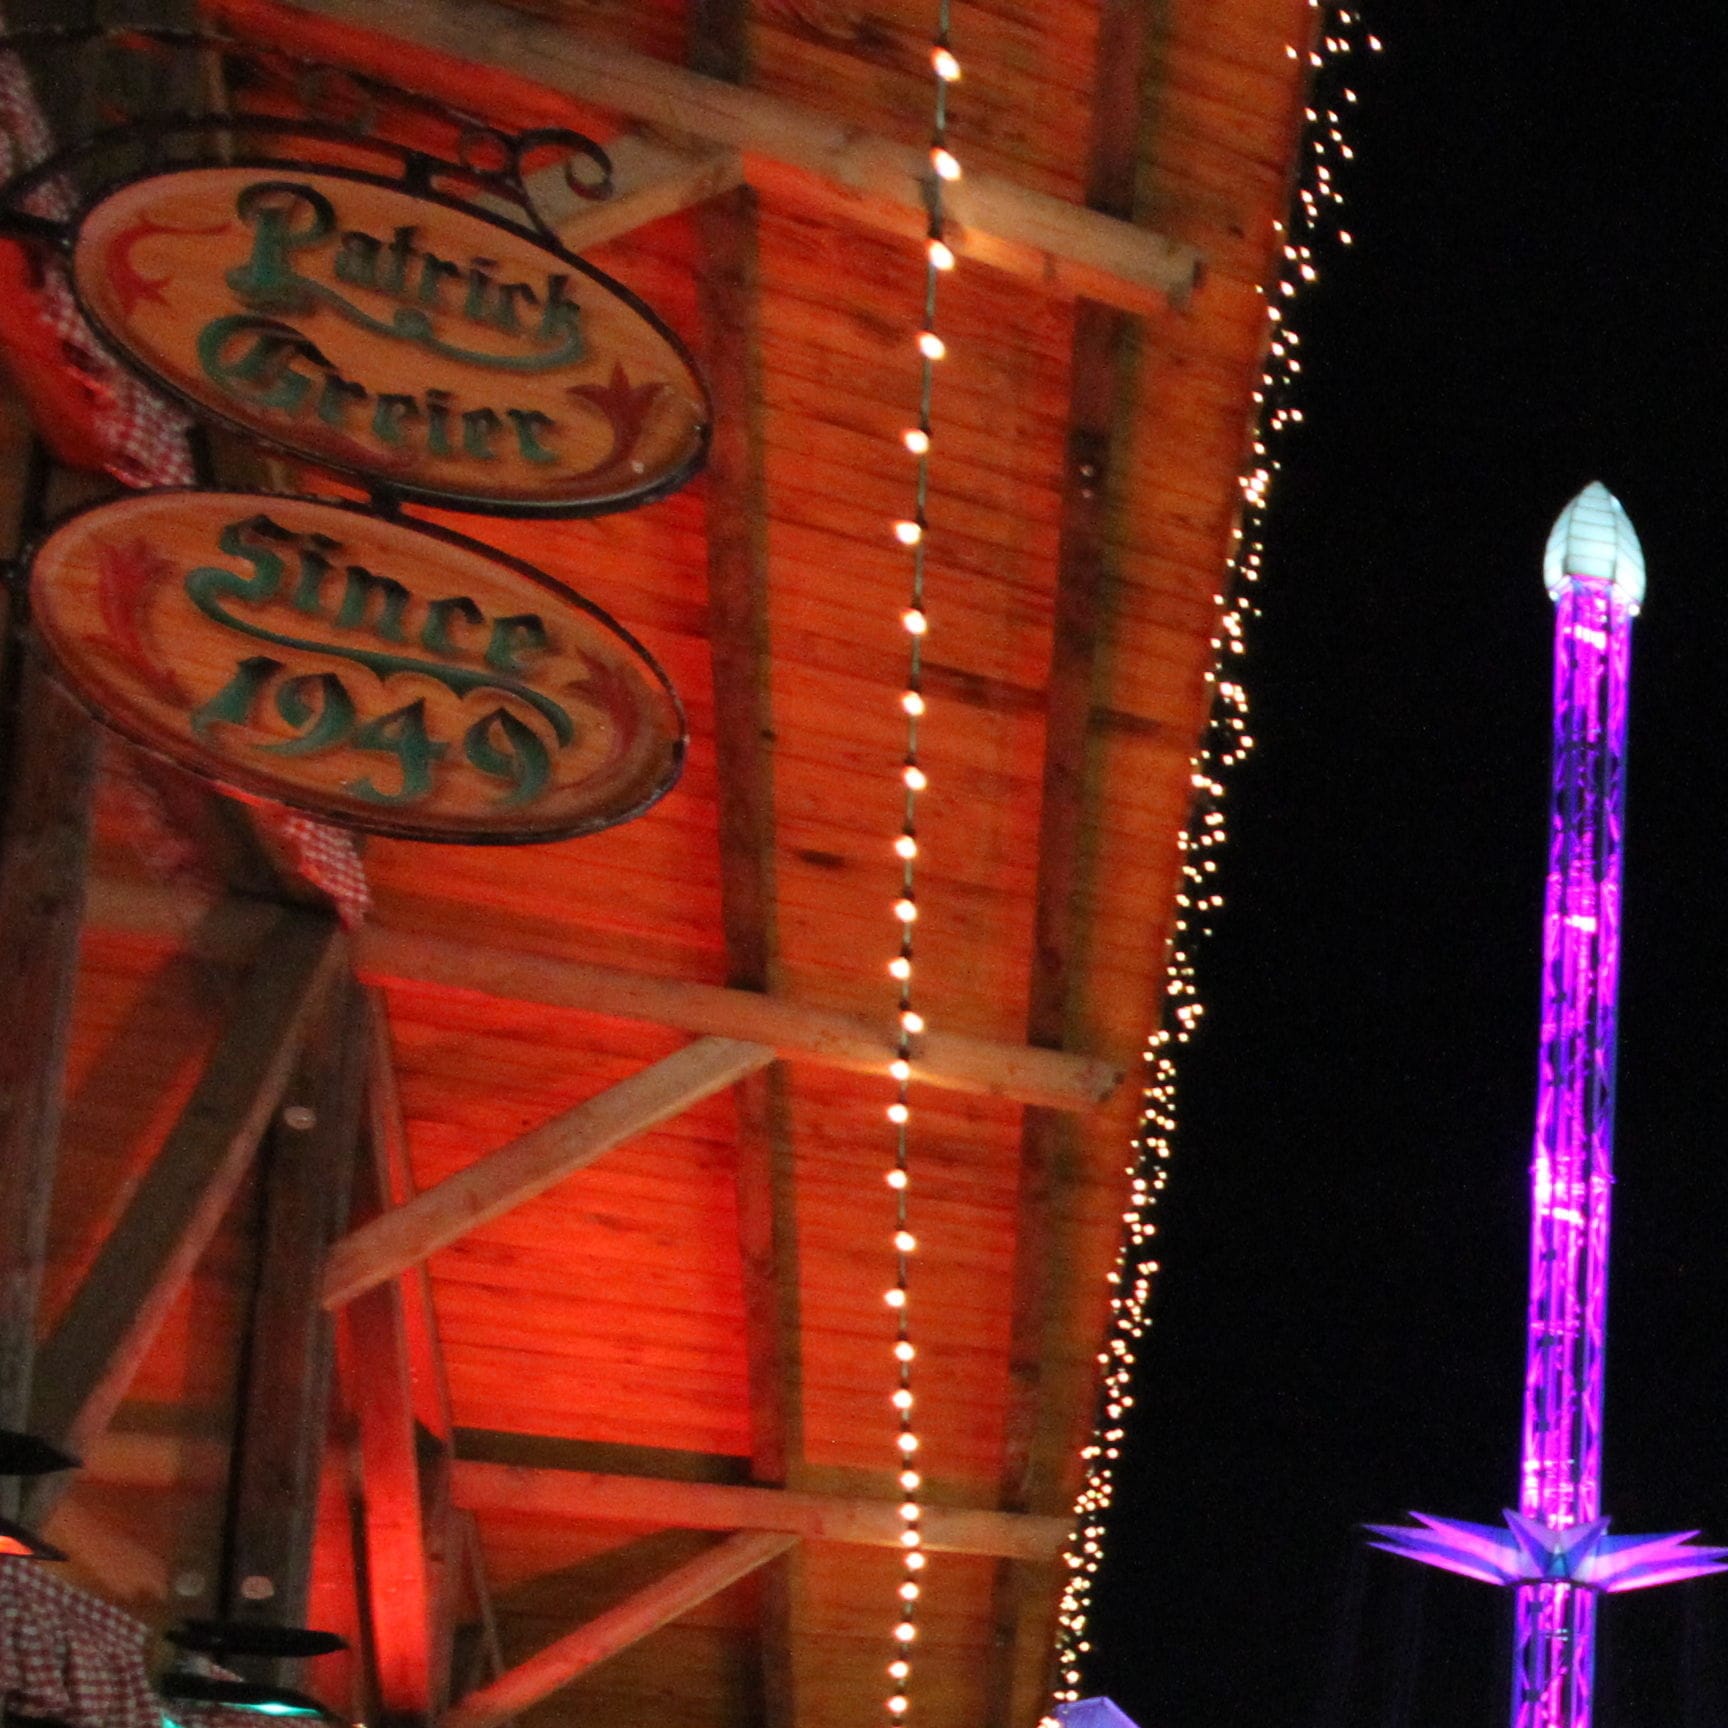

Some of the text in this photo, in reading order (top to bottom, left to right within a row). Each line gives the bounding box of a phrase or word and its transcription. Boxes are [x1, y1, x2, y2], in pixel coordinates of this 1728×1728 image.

[225, 180, 588, 370] Patrick
[197, 313, 560, 464] Greier
[185, 513, 556, 680] Since
[190, 655, 556, 803] 1949
